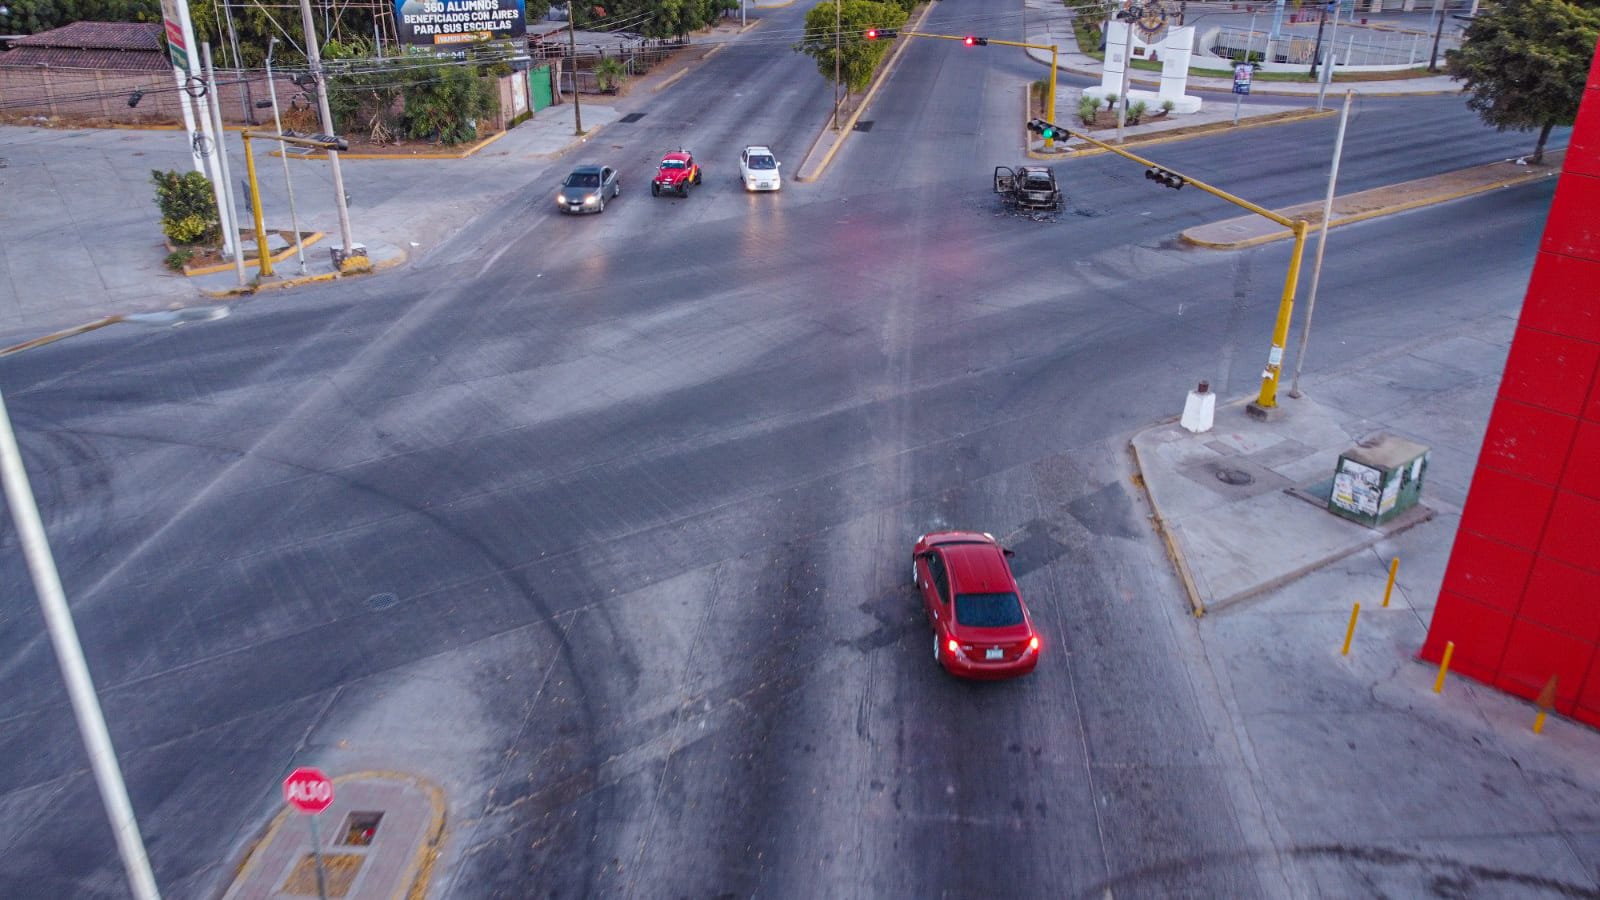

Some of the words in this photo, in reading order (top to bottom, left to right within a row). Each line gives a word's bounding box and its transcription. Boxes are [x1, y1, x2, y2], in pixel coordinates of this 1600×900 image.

[424, 2, 444, 13] 360
[447, 0, 499, 12] ALUMNOS
[404, 13, 470, 24] BENEFICIADOS
[471, 11, 490, 21] CON
[491, 9, 519, 20] AIRES
[413, 24, 441, 35] PARA
[443, 23, 462, 33] SUS
[463, 20, 512, 32] ESCUELAS
[287, 780, 331, 802] ALTO
